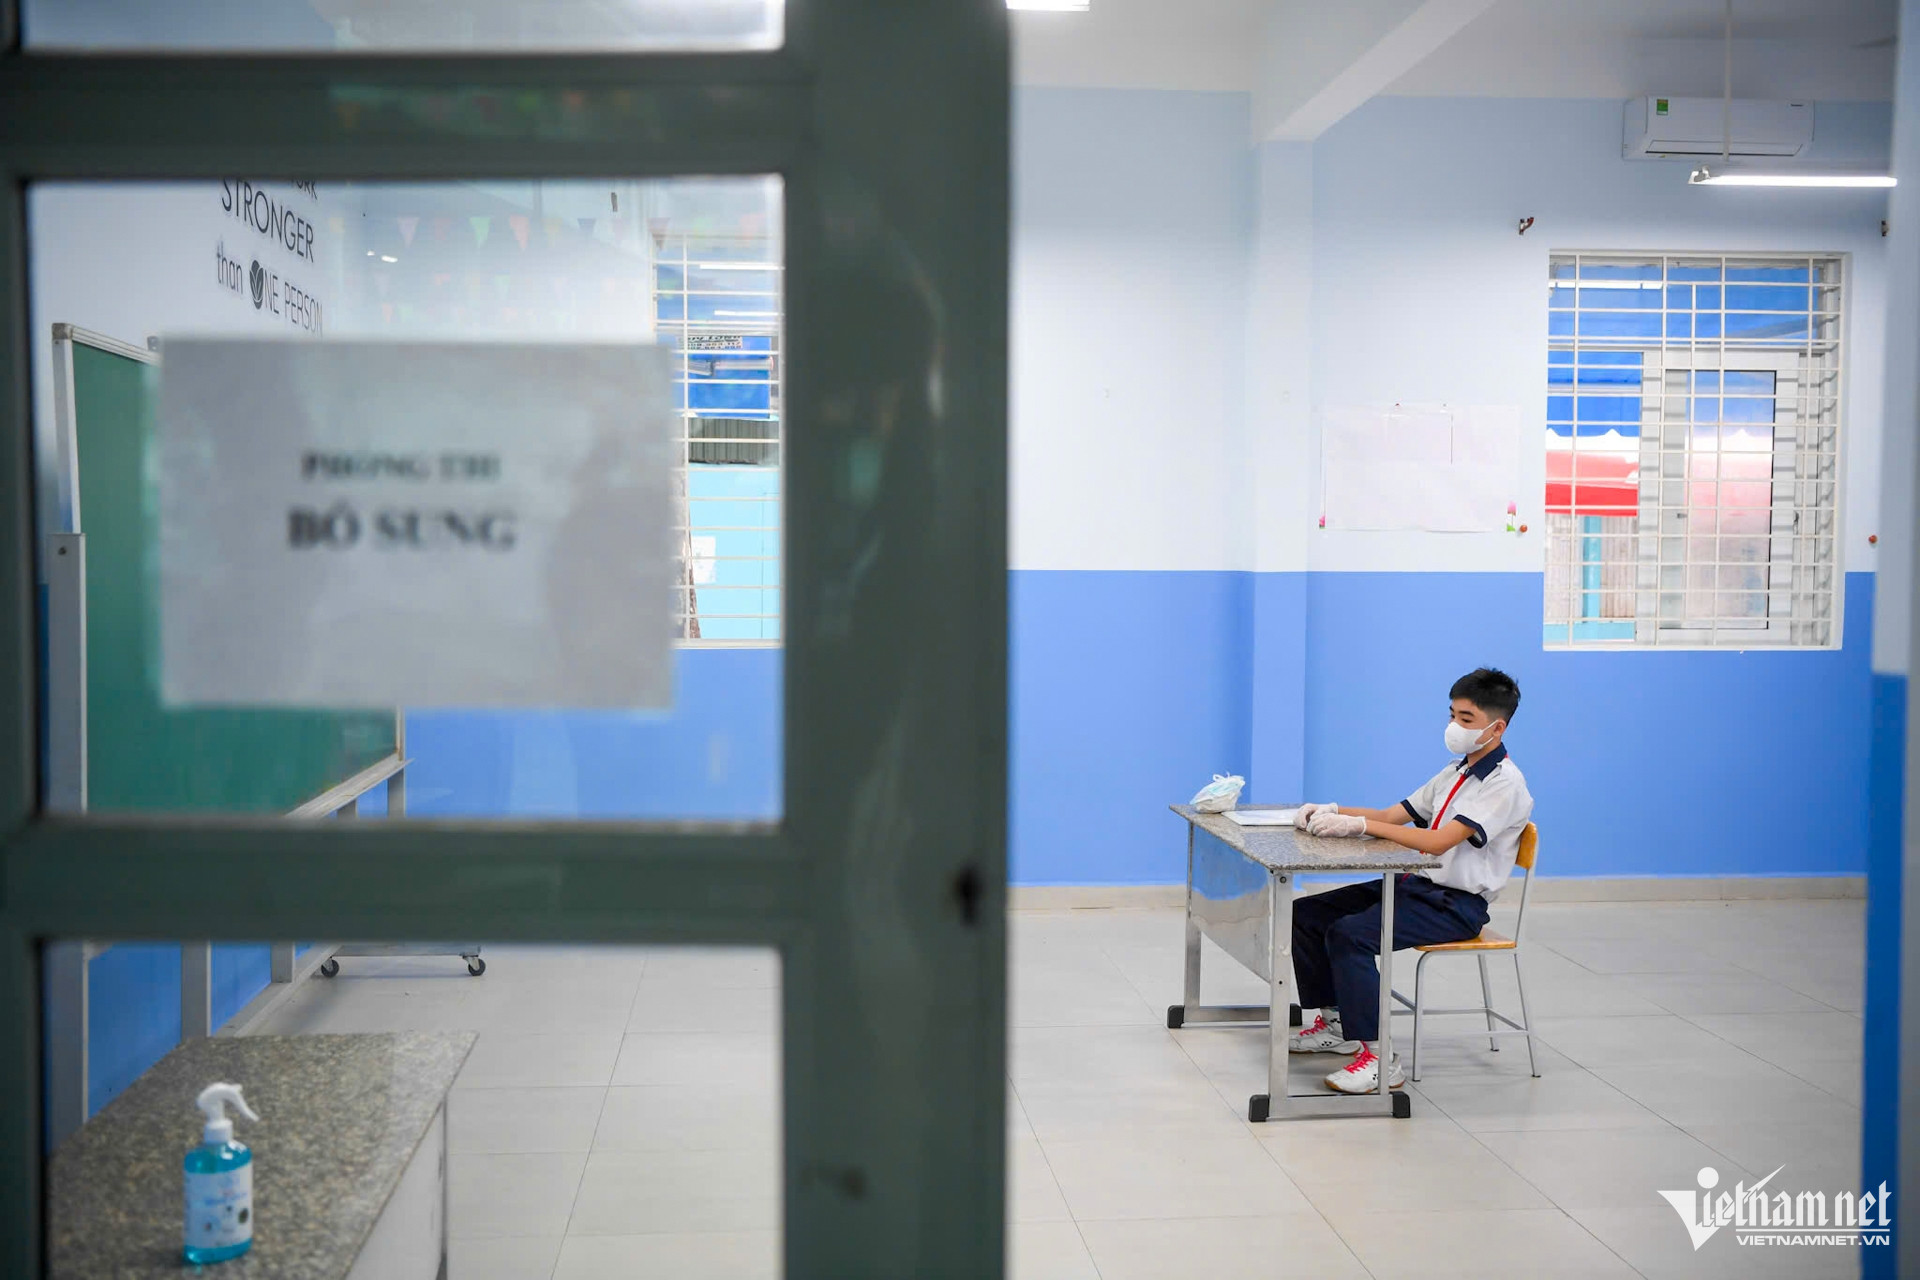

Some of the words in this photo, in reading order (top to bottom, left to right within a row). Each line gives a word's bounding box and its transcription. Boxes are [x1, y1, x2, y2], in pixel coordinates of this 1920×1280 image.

[221, 178, 314, 263] STRONGER
[217, 238, 243, 295] than
[284, 281, 323, 338] PERSON
[374, 506, 517, 551] SUNG
